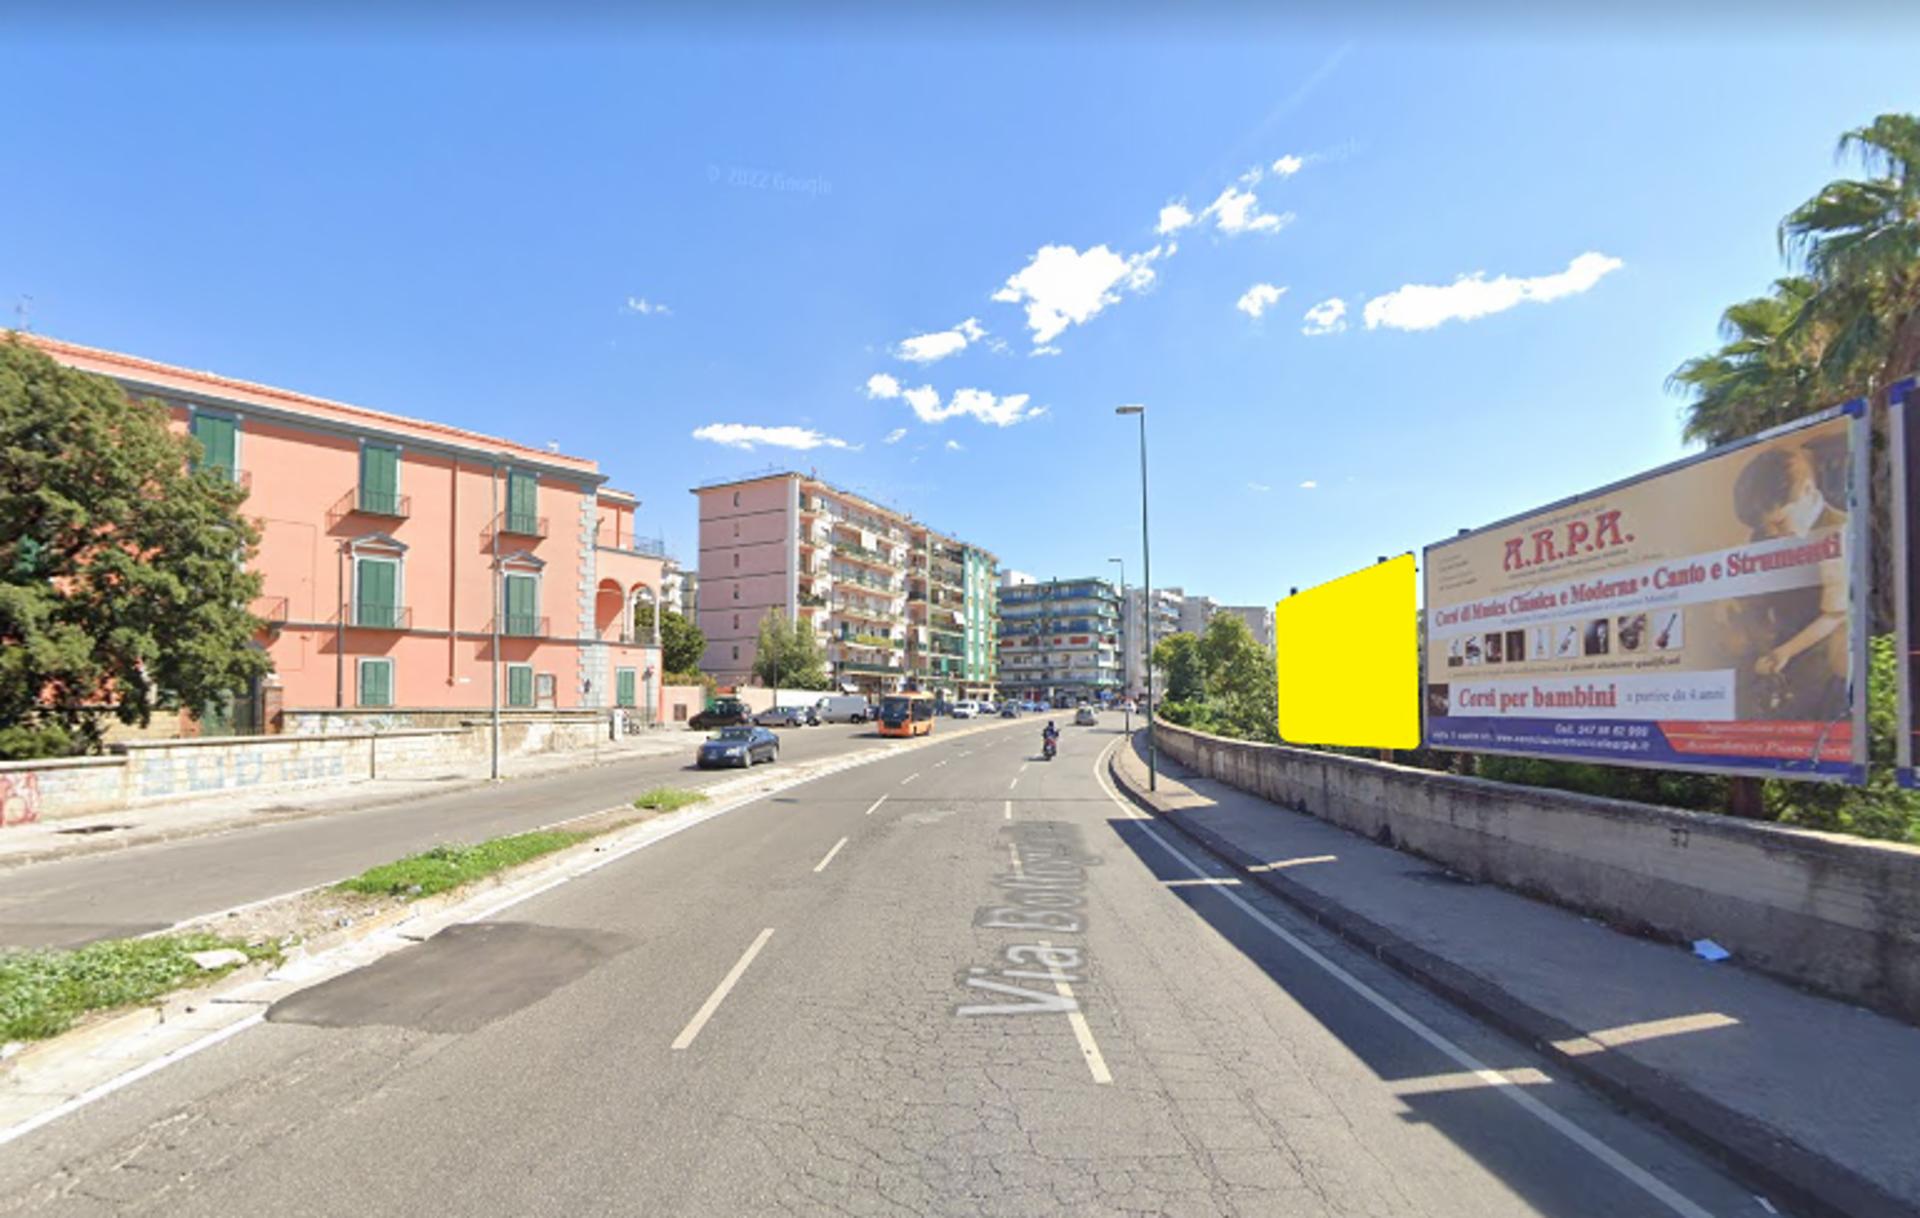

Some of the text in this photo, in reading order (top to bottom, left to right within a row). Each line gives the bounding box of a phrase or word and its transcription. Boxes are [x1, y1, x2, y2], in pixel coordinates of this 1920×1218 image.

[1503, 509, 1635, 572] A.R.P.A.
[1559, 592, 1569, 607] e
[1570, 577, 1639, 605] Moderna
[1653, 561, 1706, 589] Canto
[1710, 562, 1723, 580] e
[1726, 532, 1841, 577] Strumenti
[1459, 684, 1617, 713] Corsi per bambini
